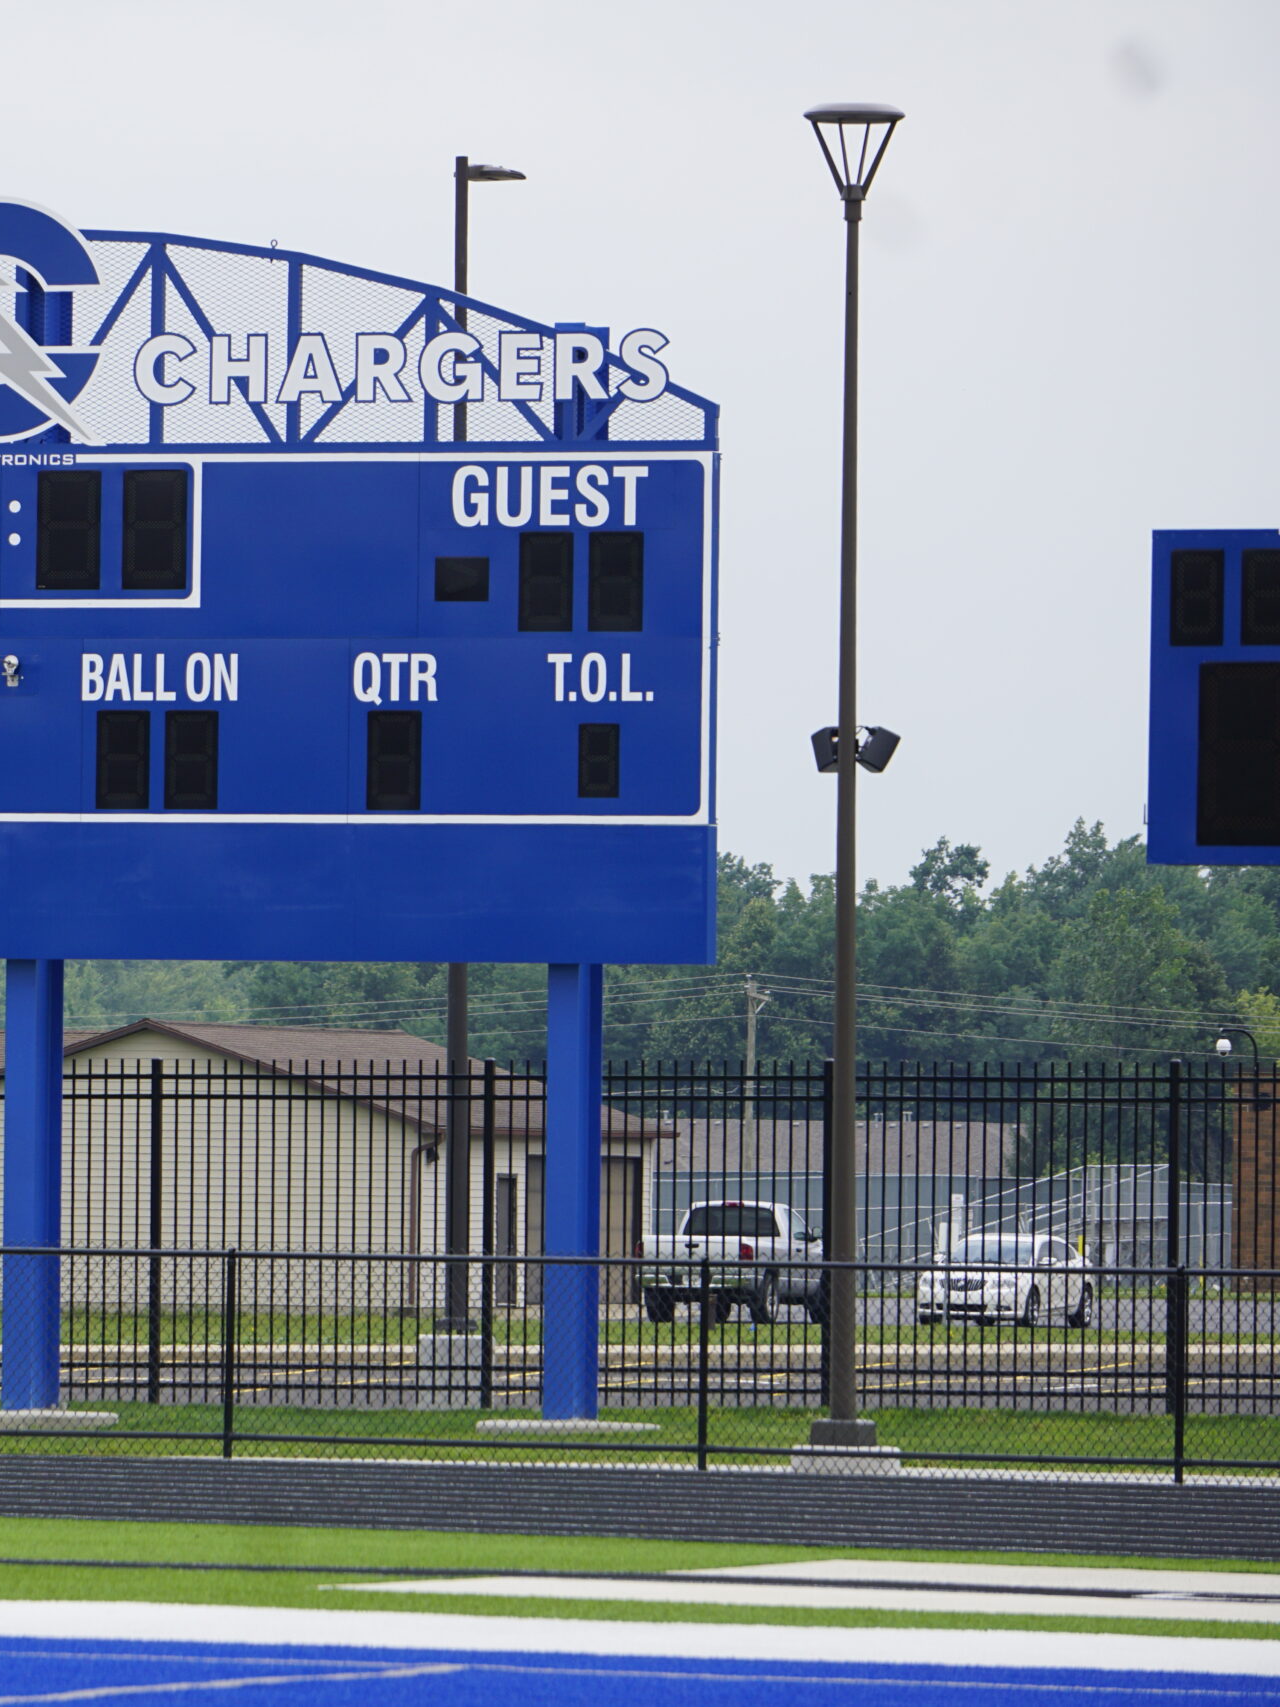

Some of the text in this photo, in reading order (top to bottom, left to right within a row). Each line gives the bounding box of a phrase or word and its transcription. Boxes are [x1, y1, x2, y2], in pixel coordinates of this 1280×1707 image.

[134, 328, 670, 404] CHARGERS
[451, 464, 649, 529] GUEST
[81, 651, 239, 702] BALL ON
[352, 651, 439, 706] QTR
[547, 652, 654, 703] T.O.L.
